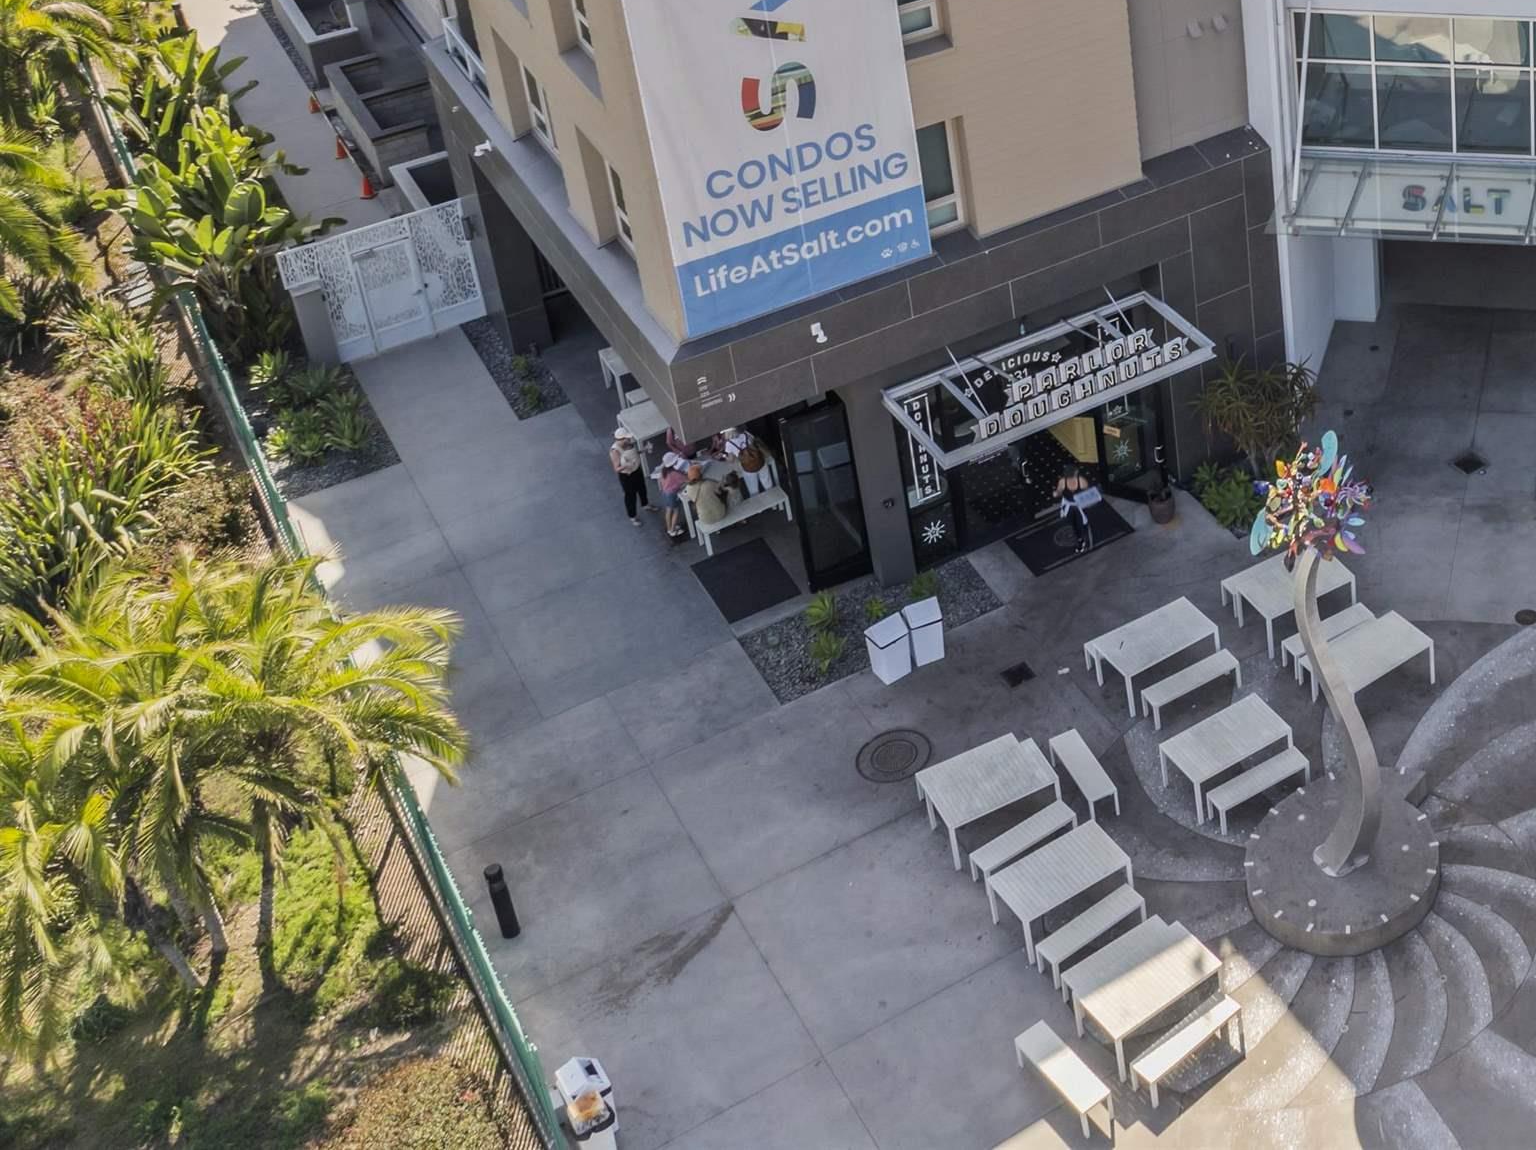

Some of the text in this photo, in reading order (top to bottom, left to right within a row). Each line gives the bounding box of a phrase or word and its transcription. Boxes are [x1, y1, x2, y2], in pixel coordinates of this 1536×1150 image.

[682, 152, 909, 249] NOW SELLING
[705, 123, 877, 200] CONDOS
[693, 205, 914, 299] LifeAtSalt.com
[984, 342, 1184, 438] DOUGHNUTS
[1016, 332, 1149, 401] PARLOR
